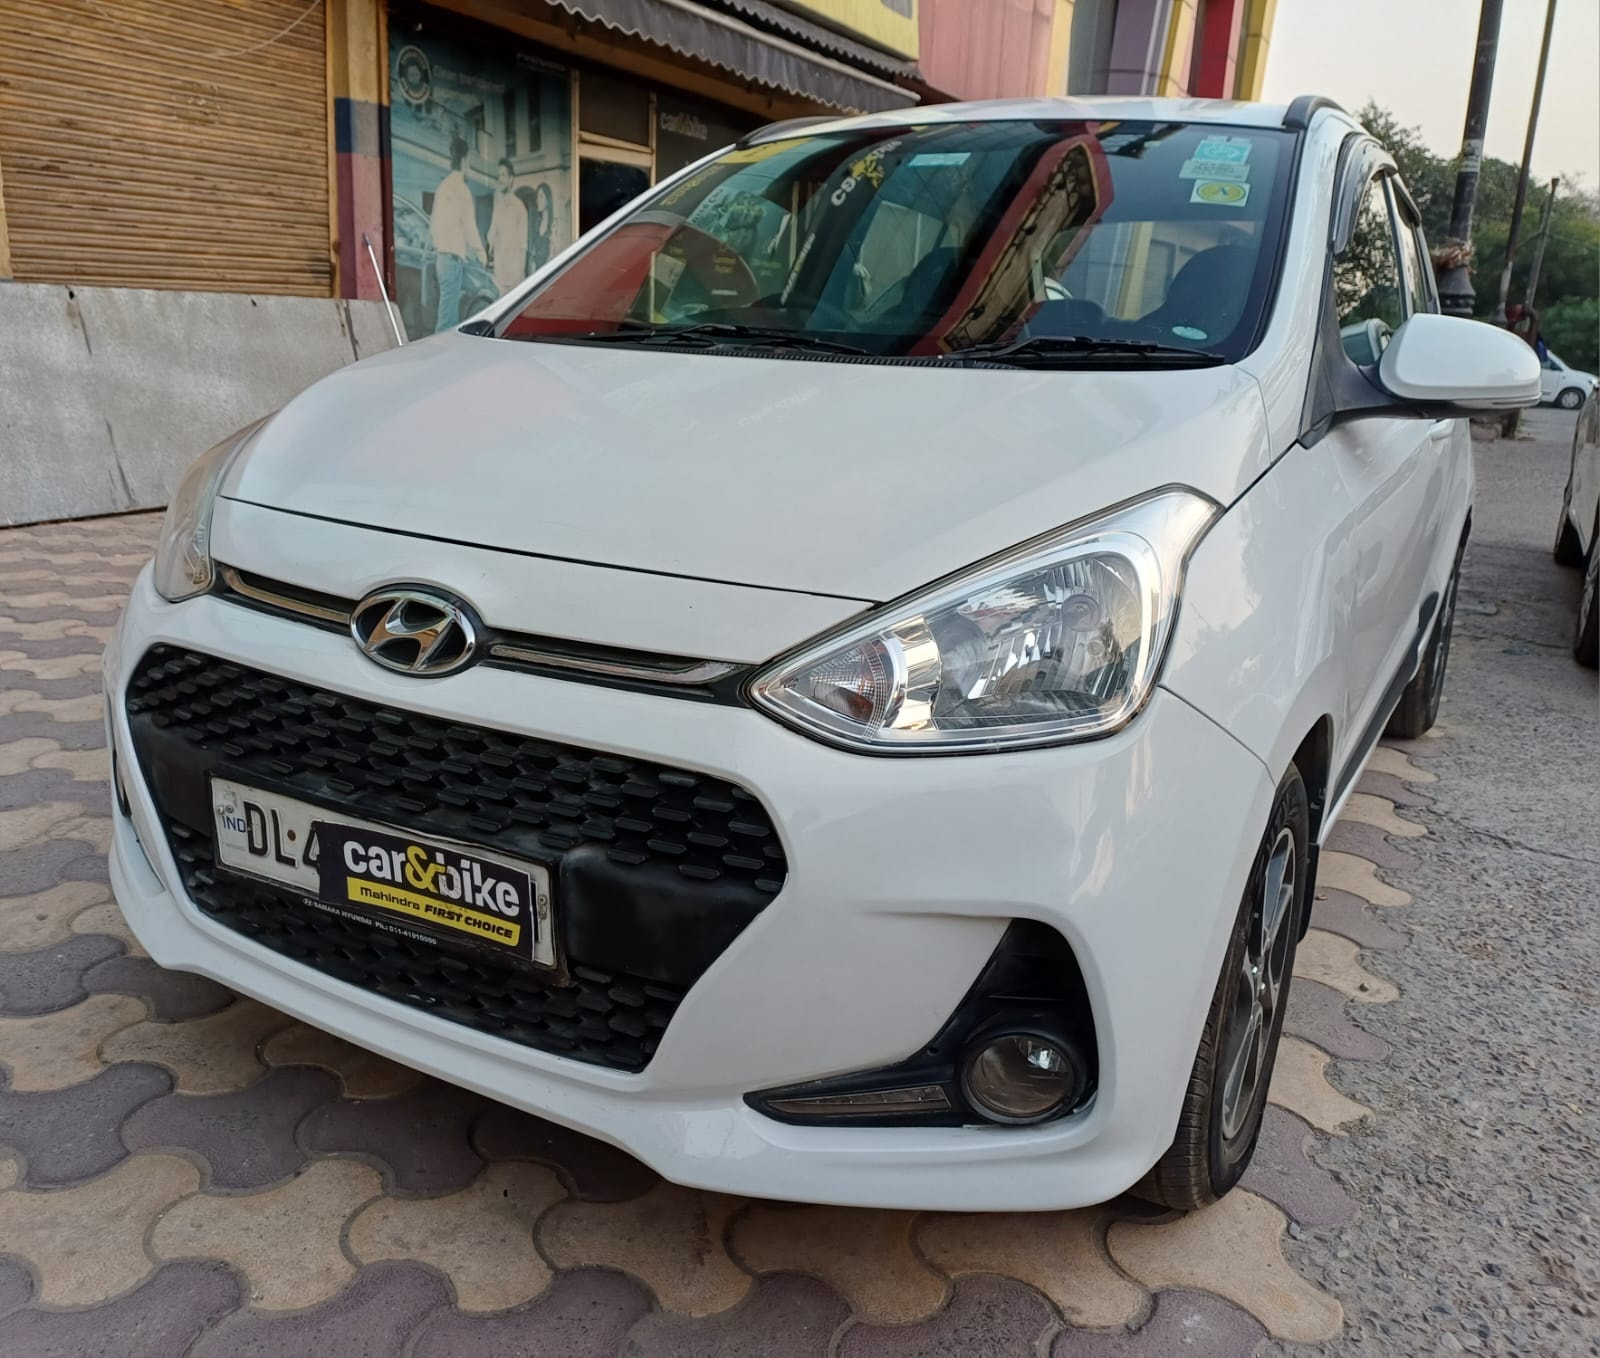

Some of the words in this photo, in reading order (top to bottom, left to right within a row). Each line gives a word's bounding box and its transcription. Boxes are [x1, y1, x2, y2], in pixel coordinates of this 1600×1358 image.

[222, 815, 247, 833] IND
[343, 840, 520, 917] car&bike
[341, 911, 373, 926] HYUNDAI
[360, 886, 420, 910] Mahindra
[424, 904, 463, 922] FIRST
[464, 916, 513, 939] CHOICE
